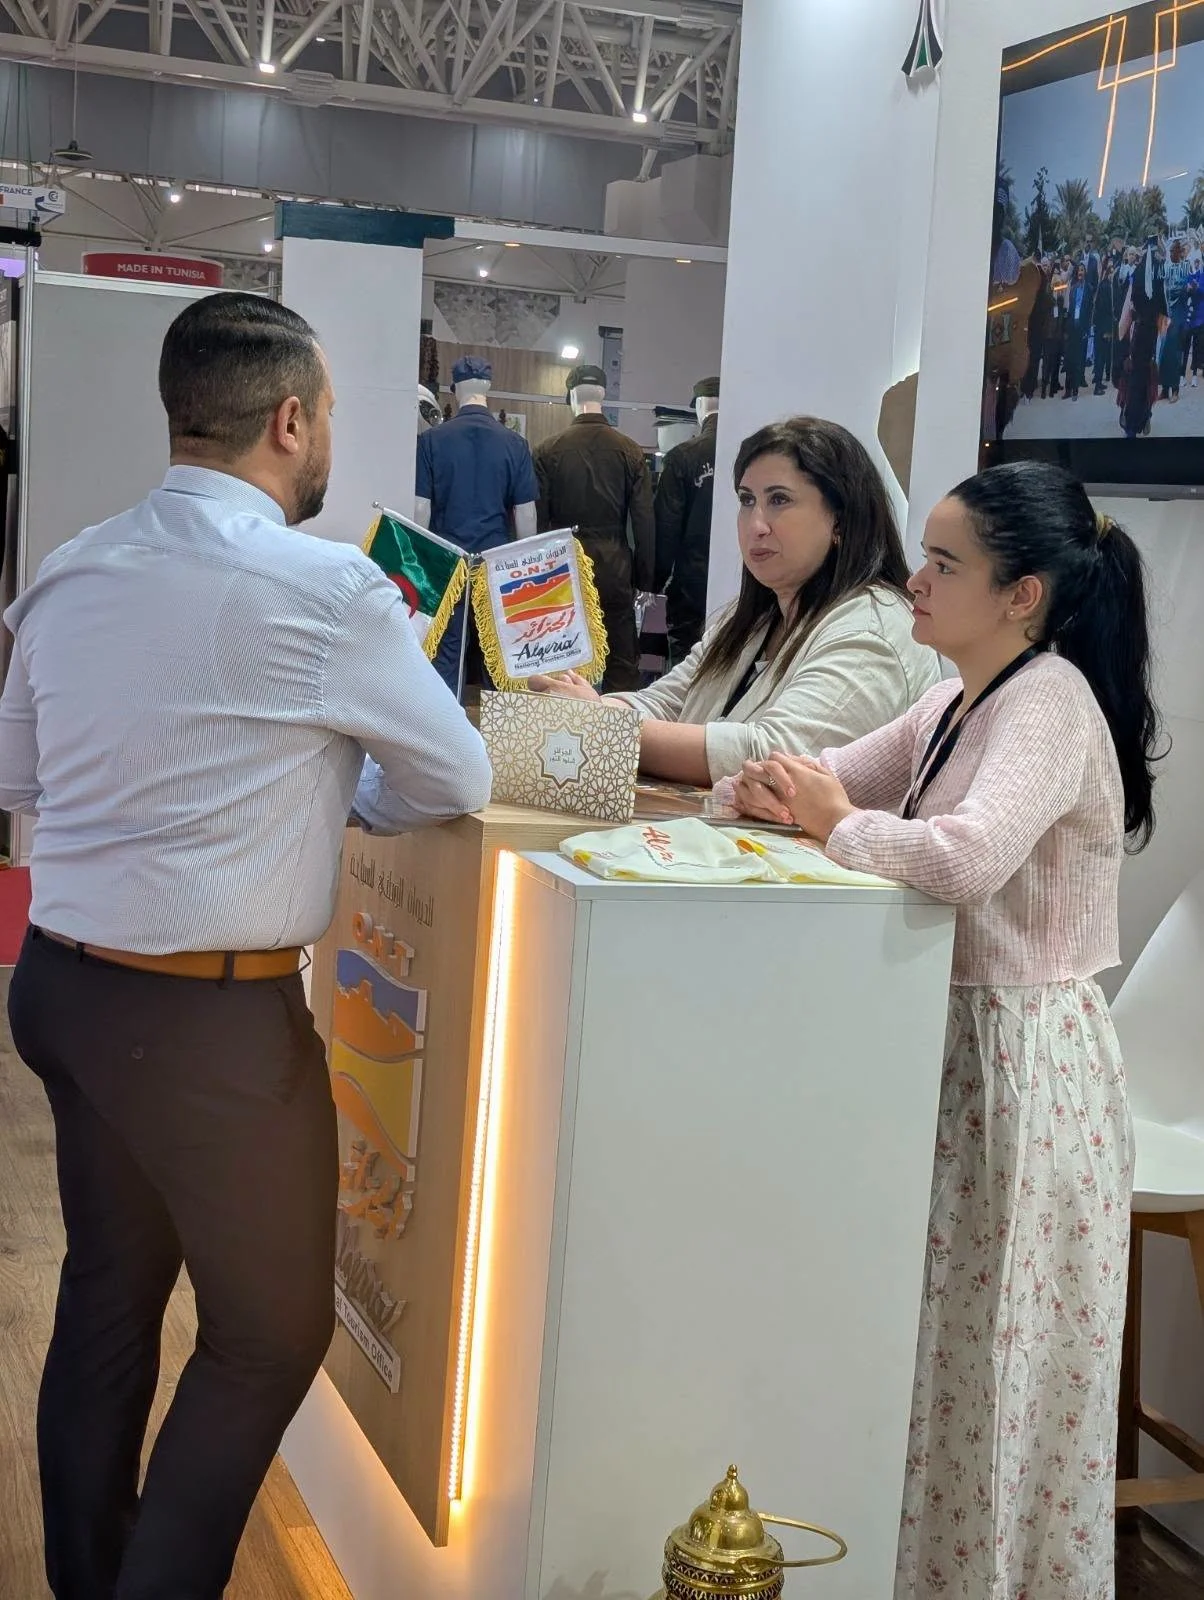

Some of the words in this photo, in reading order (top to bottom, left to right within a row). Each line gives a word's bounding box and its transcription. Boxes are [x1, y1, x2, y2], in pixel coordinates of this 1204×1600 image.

[117, 263, 148, 273] MADE
[151, 265, 163, 275] IN
[165, 266, 206, 280] TUNISIA
[512, 609, 576, 645] الجزائر
[512, 632, 580, 661] Algeria
[377, 870, 405, 909] الوطني
[407, 885, 434, 928] الديوان
[343, 1302, 370, 1352] Tourism
[371, 1343, 393, 1383] Office
